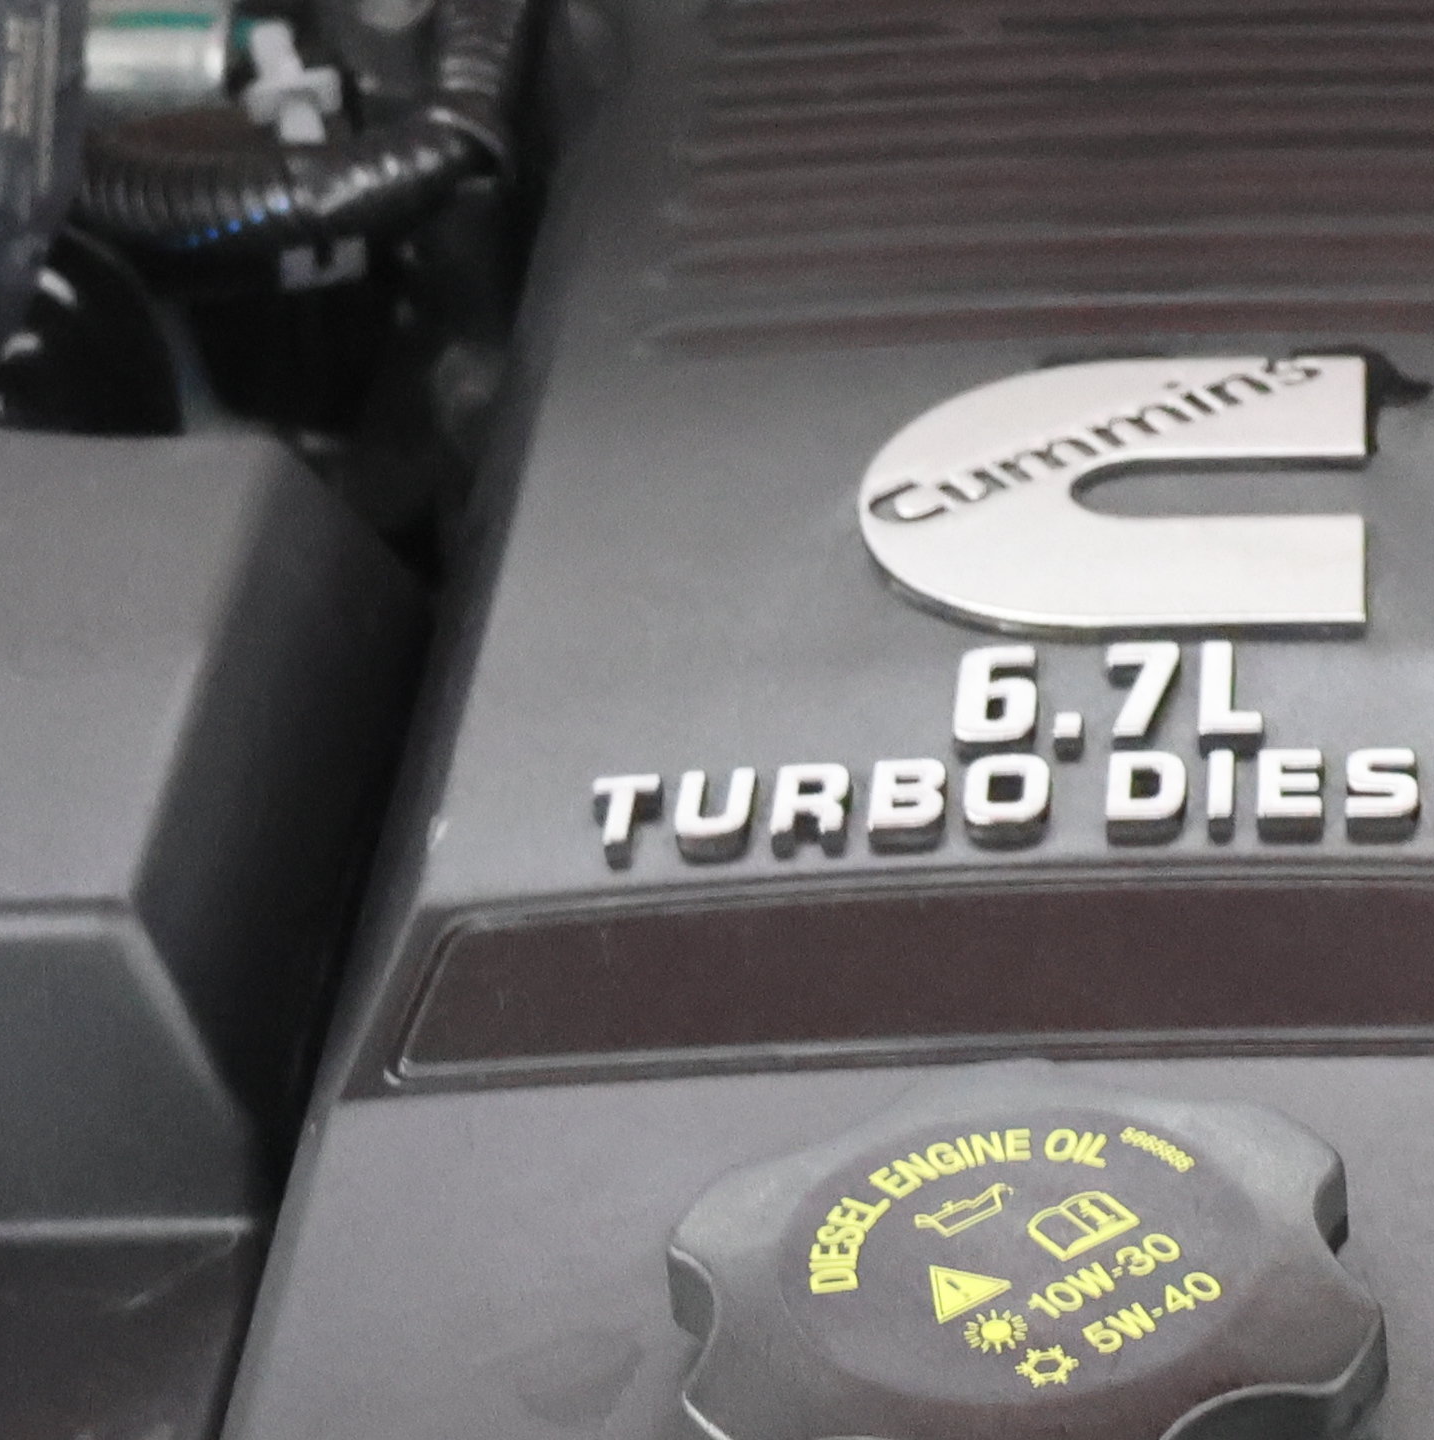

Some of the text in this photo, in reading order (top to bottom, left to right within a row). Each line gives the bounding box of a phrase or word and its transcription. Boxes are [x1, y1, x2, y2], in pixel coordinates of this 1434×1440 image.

[867, 358, 1324, 523] Cummins
[952, 641, 1264, 754] 6.7L
[593, 752, 1054, 858] TURBO
[809, 1128, 1108, 1294] DIESEL ENGINE OIL
[1027, 1231, 1183, 1320] 10W-30
[1082, 1271, 1223, 1355] 5W-40
